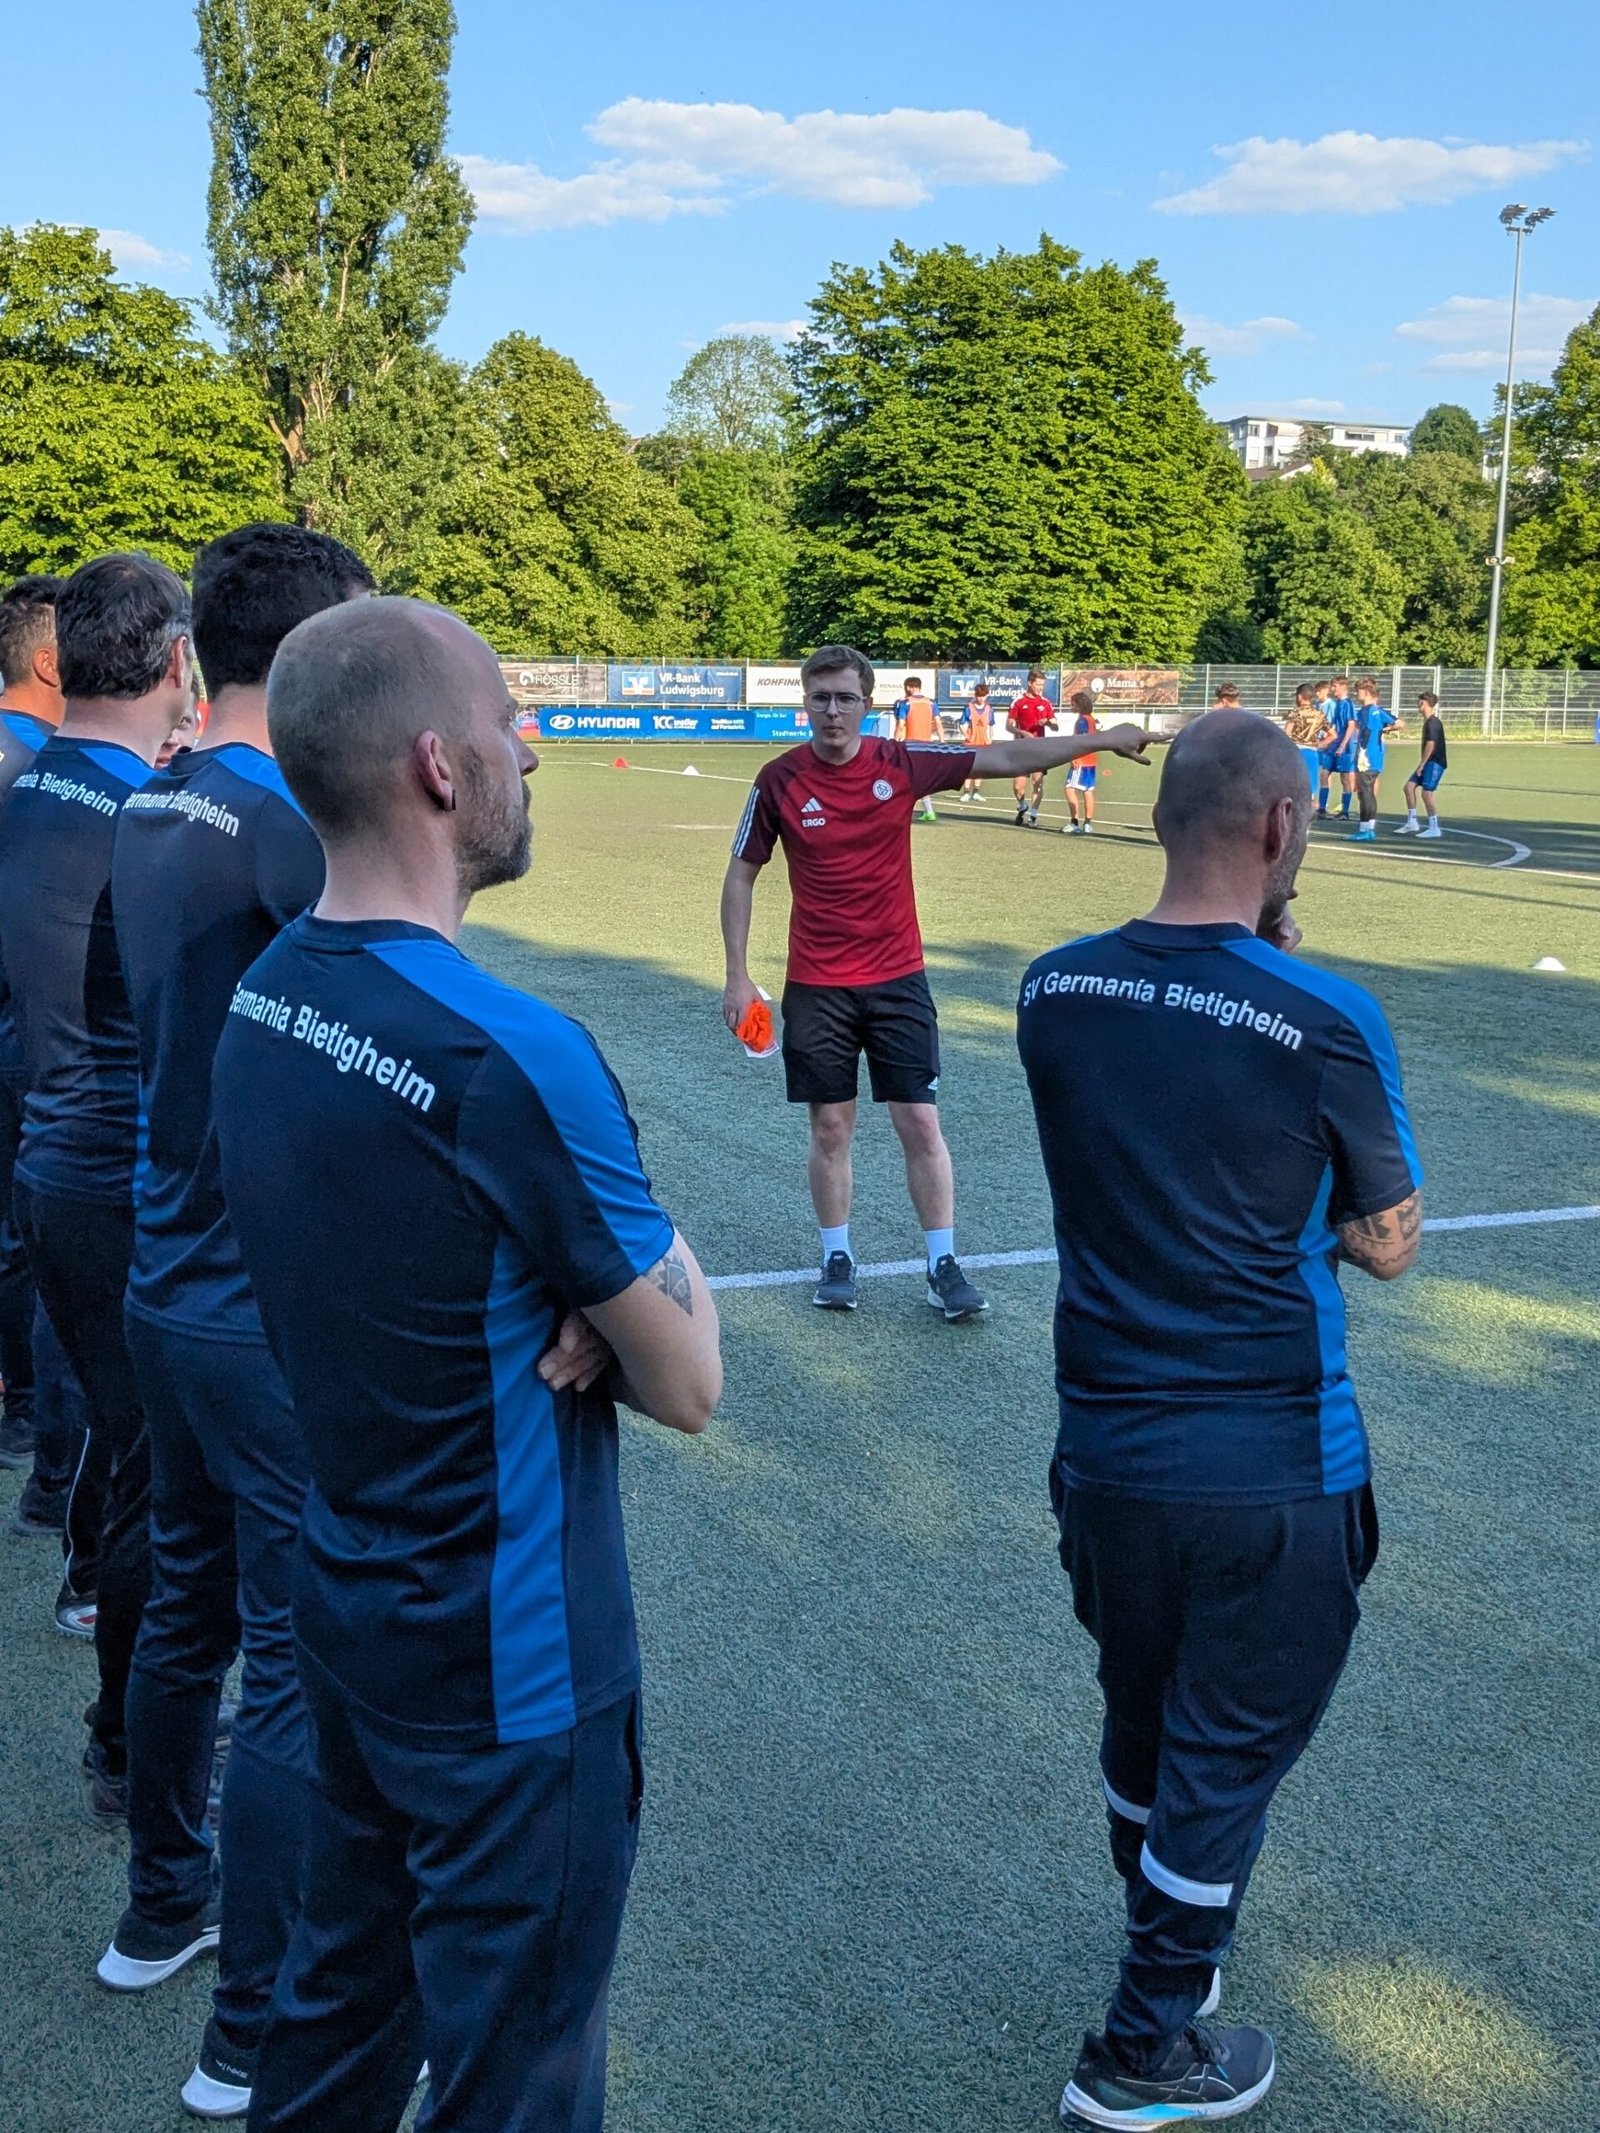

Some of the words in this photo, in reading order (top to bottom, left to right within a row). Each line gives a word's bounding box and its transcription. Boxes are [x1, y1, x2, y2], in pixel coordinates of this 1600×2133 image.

[659, 672, 700, 683] VR-Bank
[756, 678, 801, 687] KOHFINK
[984, 675, 1021, 686] VR-Bank
[659, 685, 724, 697] Ludwigsburg
[577, 716, 640, 729] HYUNDAI
[39, 772, 118, 817] Bietigheim
[168, 790, 239, 837] Bietigheim
[802, 817, 826, 828] ERGO
[1043, 971, 1156, 1003] Germania
[1164, 983, 1303, 1051] Bietigheim
[292, 1004, 436, 1113] Bietigheim
